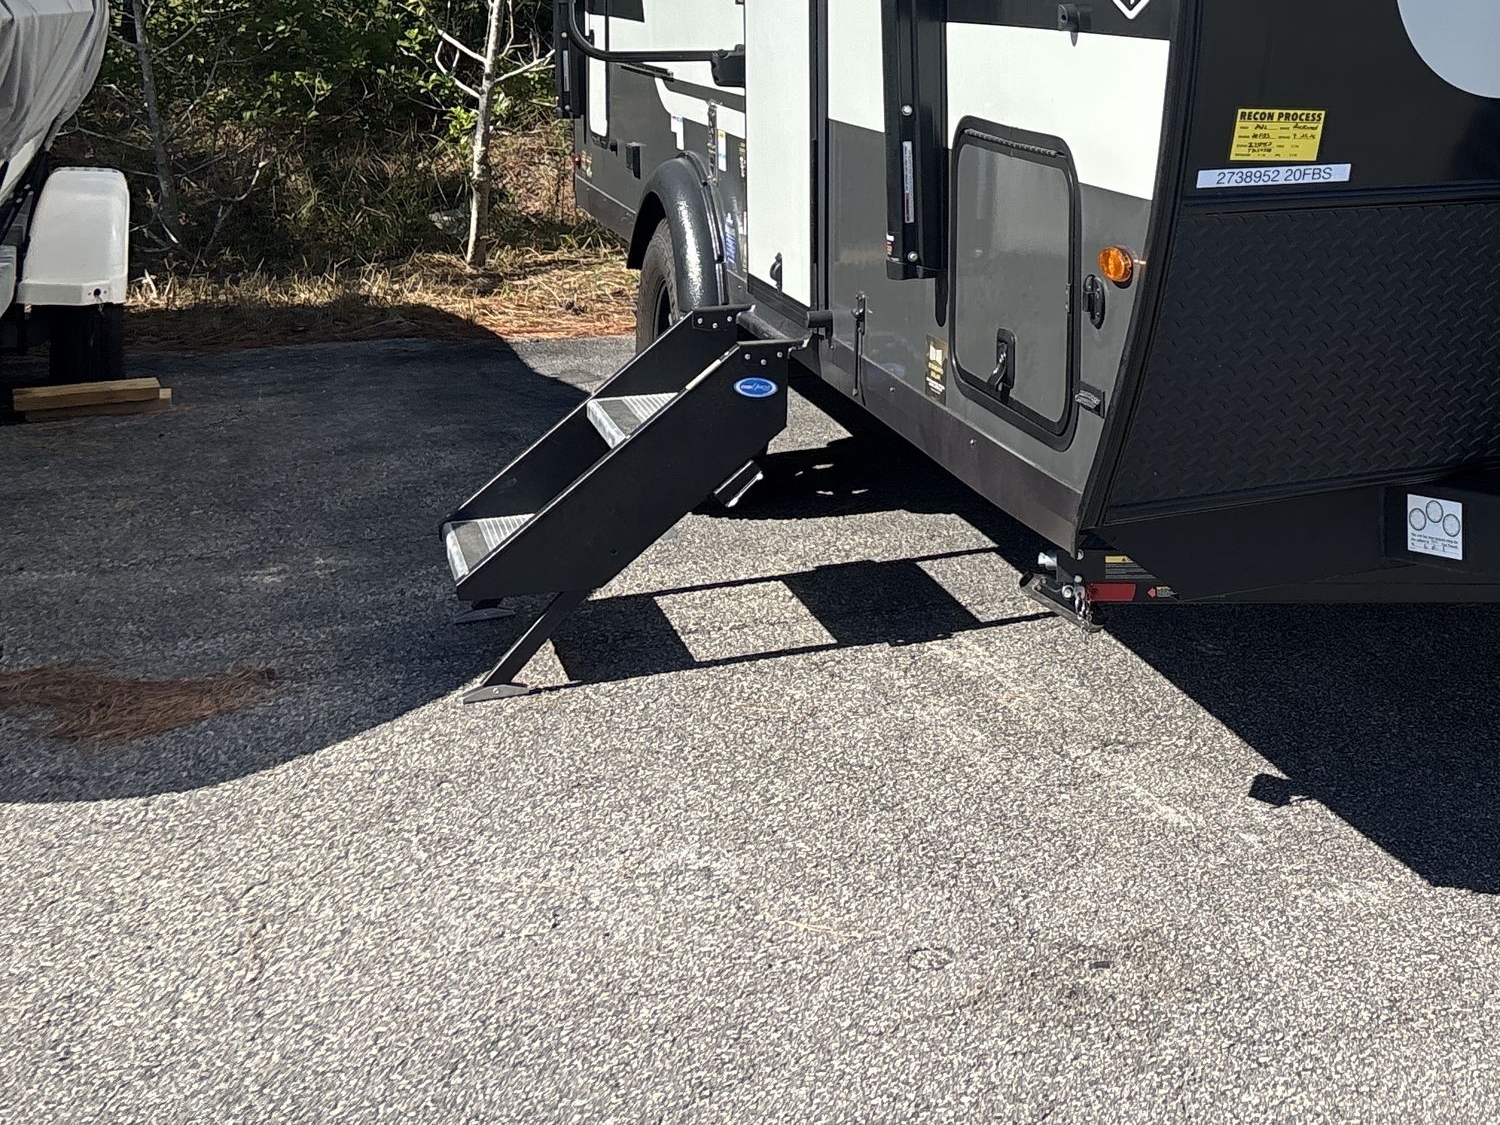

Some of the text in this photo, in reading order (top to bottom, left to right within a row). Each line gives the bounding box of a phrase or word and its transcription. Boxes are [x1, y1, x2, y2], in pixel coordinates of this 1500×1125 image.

[1240, 111, 1323, 122] RECON PROCESS
[1217, 166, 1333, 185] 2738952 20FBS
